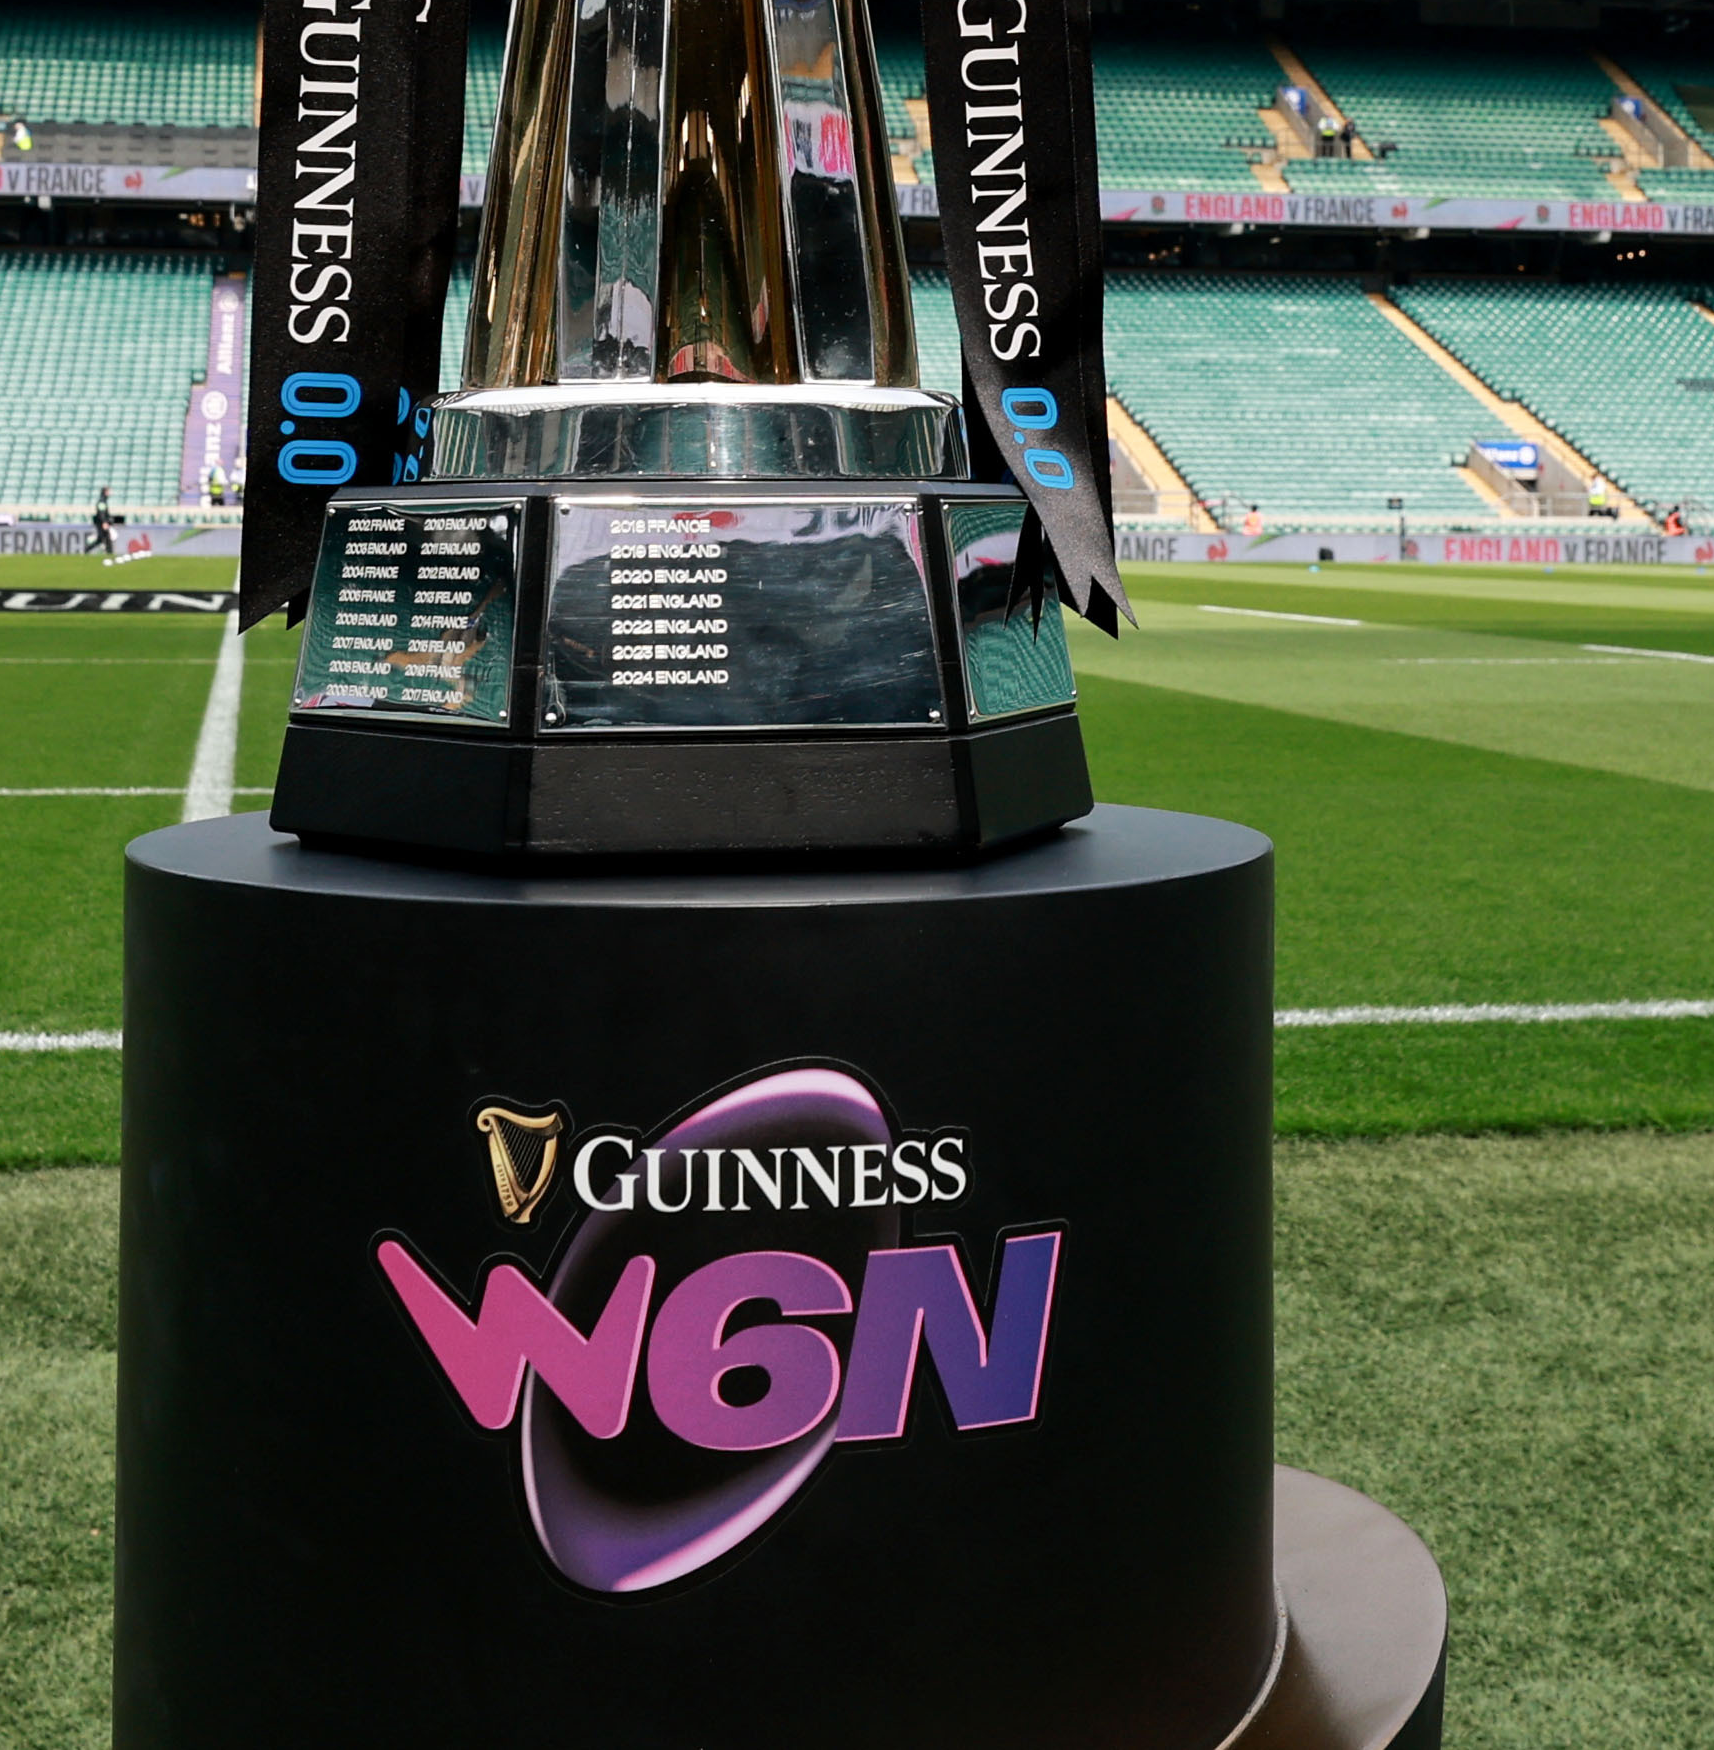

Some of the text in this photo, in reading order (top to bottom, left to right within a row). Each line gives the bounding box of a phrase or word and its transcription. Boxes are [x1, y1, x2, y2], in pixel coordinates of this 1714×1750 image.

[25, 166, 106, 194] FRANCE
[1185, 194, 1284, 220] ENGLAND
[1303, 197, 1374, 222] FRANCE
[1569, 203, 1664, 229] ENGLAND
[216, 313, 235, 375] Allianz
[278, 372, 361, 485] 0.0
[1001, 386, 1074, 490] 0.0
[371, 519, 405, 532] FRANCE
[445, 518, 487, 531] ENGLAND
[610, 520, 710, 534] 2018 FRANCE
[368, 543, 407, 555] ENGLAND
[439, 543, 481, 555] ENGLAND
[610, 544, 721, 559] 2019 ENGLAND
[1119, 537, 1179, 561] ANCE
[1444, 538, 1560, 562] ENGLAND
[1586, 539, 1667, 563] FRANCE
[365, 566, 399, 579] FRANCE
[438, 567, 480, 580] ENGLAND
[611, 569, 728, 584] 2020 ENGLAND
[361, 590, 396, 603] FRANCE
[611, 594, 723, 609] 2021 ENGLAND
[358, 613, 397, 626] ENGLAND
[432, 615, 469, 629] FRANCE
[612, 619, 728, 635] 2022 ENGLAND
[354, 637, 393, 650] ENGLAND
[612, 645, 729, 660] 2023 ENGLAND
[352, 661, 391, 675] ENGLAND
[426, 664, 462, 678] FRANCE
[612, 670, 729, 685] 2024 ENGLAND
[349, 684, 388, 698] ENGLAND
[422, 688, 464, 703] ENGLAND
[573, 1135, 967, 1213] GUINNESS
[377, 1230, 1062, 1451] W6N
